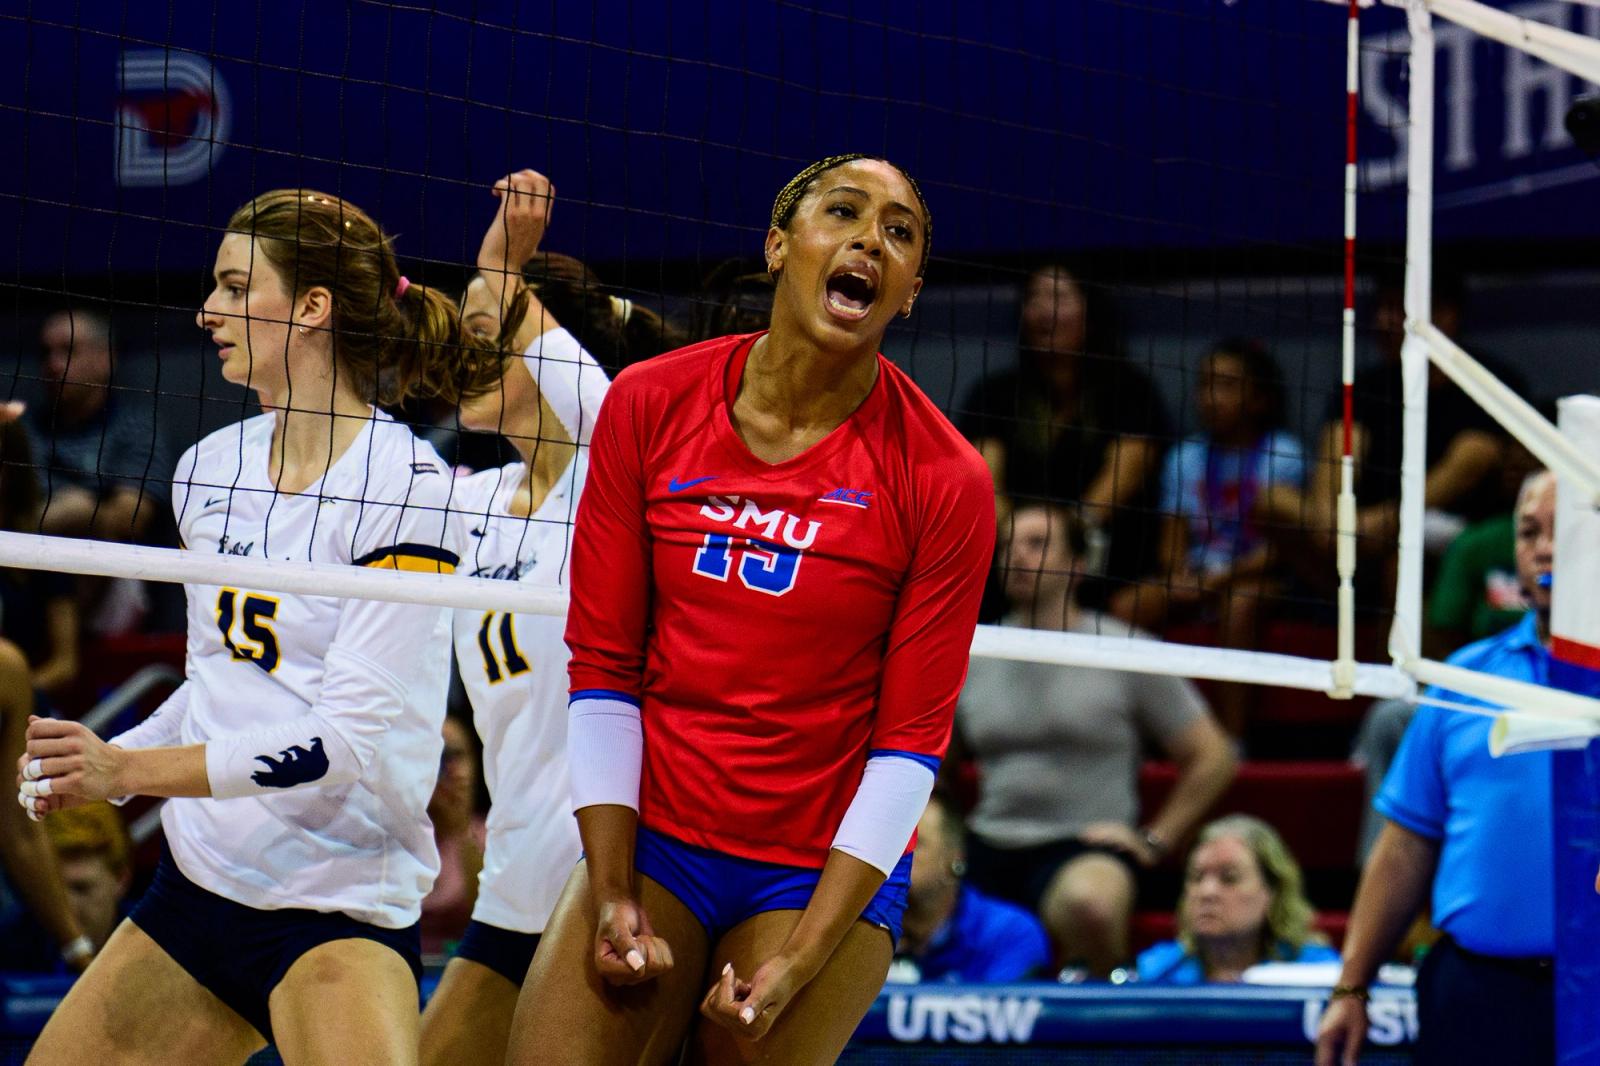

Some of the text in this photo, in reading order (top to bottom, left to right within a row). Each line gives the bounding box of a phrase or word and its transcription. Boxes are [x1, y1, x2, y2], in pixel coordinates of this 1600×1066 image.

[699, 495, 823, 550] SMU
[821, 487, 873, 507] ACC
[214, 586, 281, 675] 15
[476, 608, 533, 685] 11
[886, 996, 1043, 1043] UTSW
